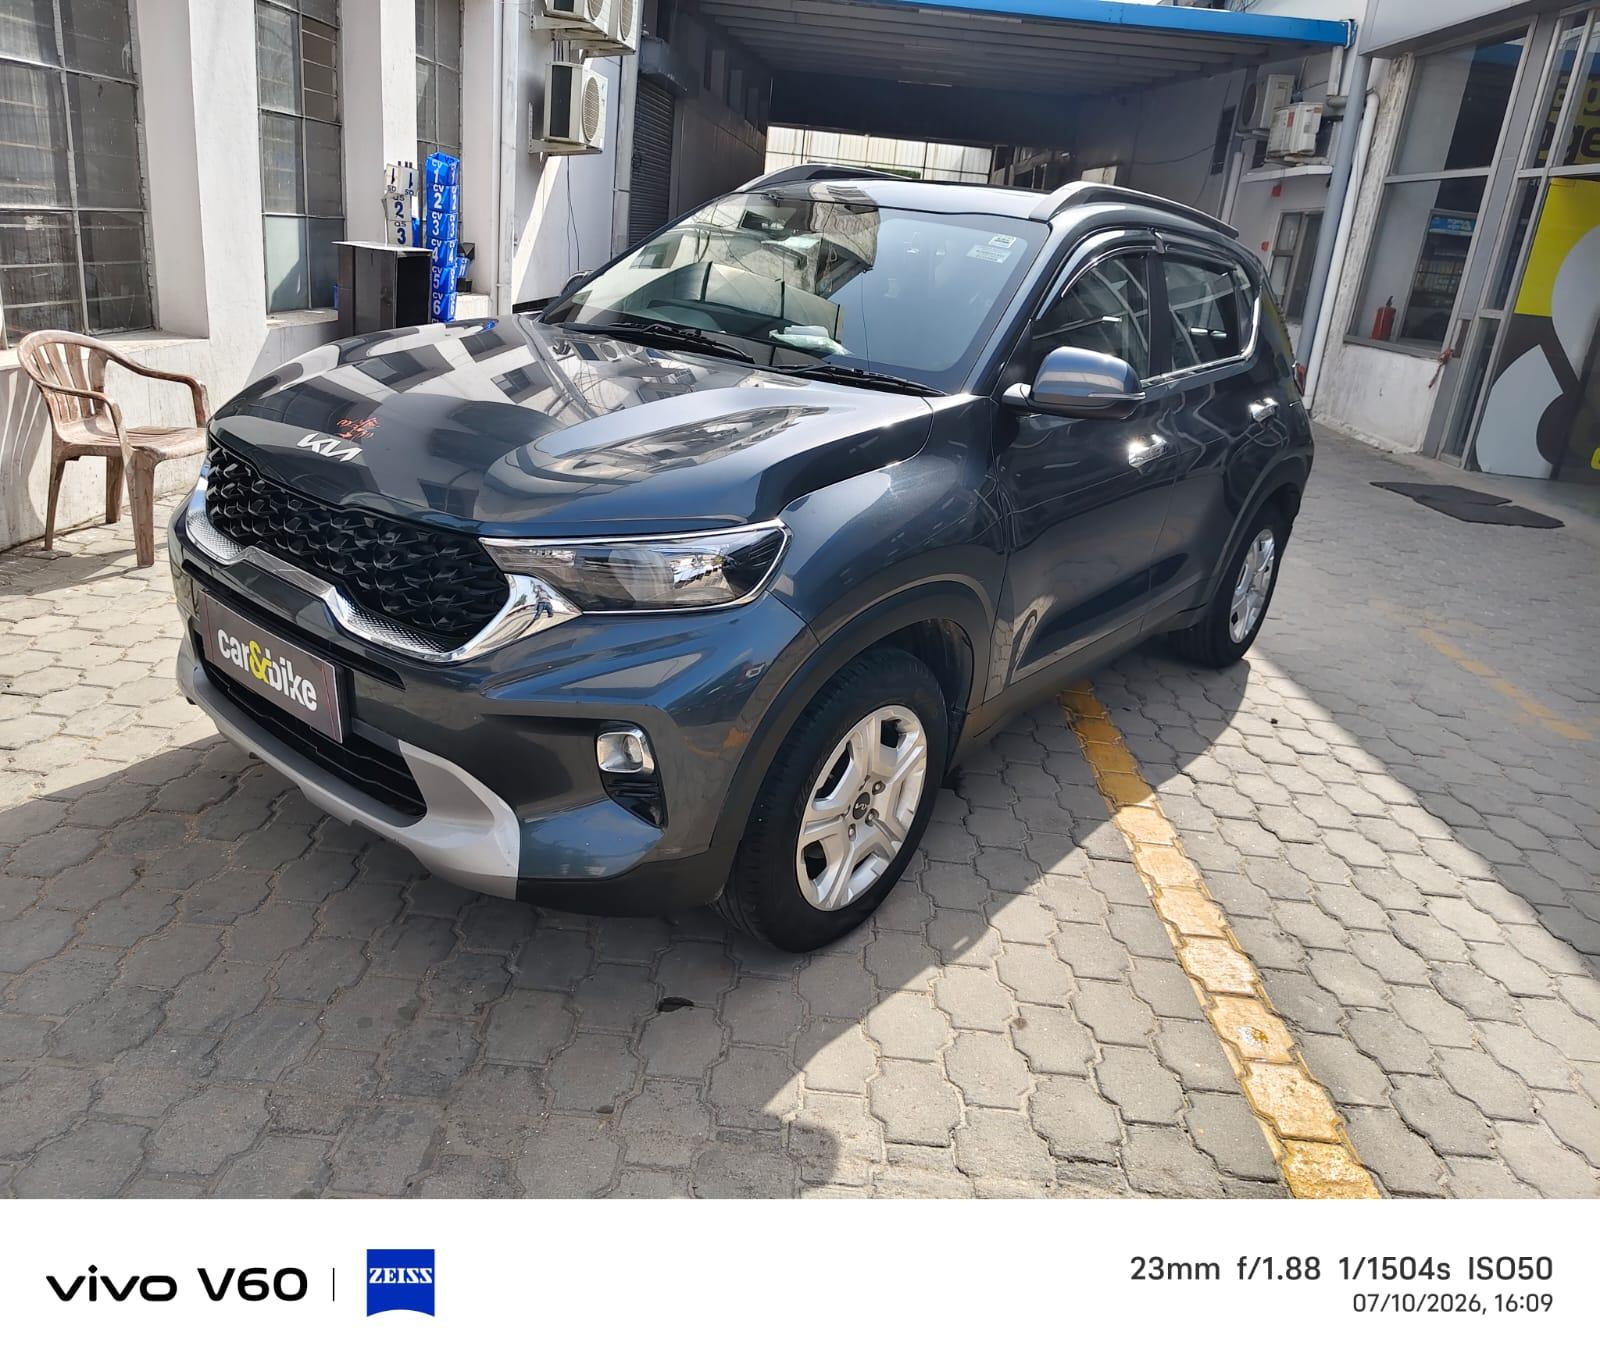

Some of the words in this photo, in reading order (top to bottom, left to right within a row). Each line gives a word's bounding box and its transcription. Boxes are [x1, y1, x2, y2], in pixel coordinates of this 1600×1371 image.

[433, 168, 440, 184] 1
[433, 184, 444, 193] CV
[434, 192, 443, 209] 2
[394, 201, 404, 219] 2
[431, 211, 443, 220] CV
[432, 220, 440, 236] 3
[397, 228, 407, 245] 3
[431, 238, 442, 248] CV
[431, 247, 439, 263] 4
[432, 266, 443, 274] CV
[433, 273, 440, 289] 5
[432, 292, 443, 300] CV
[433, 299, 441, 316] 6
[217, 629, 318, 712] car&bike
